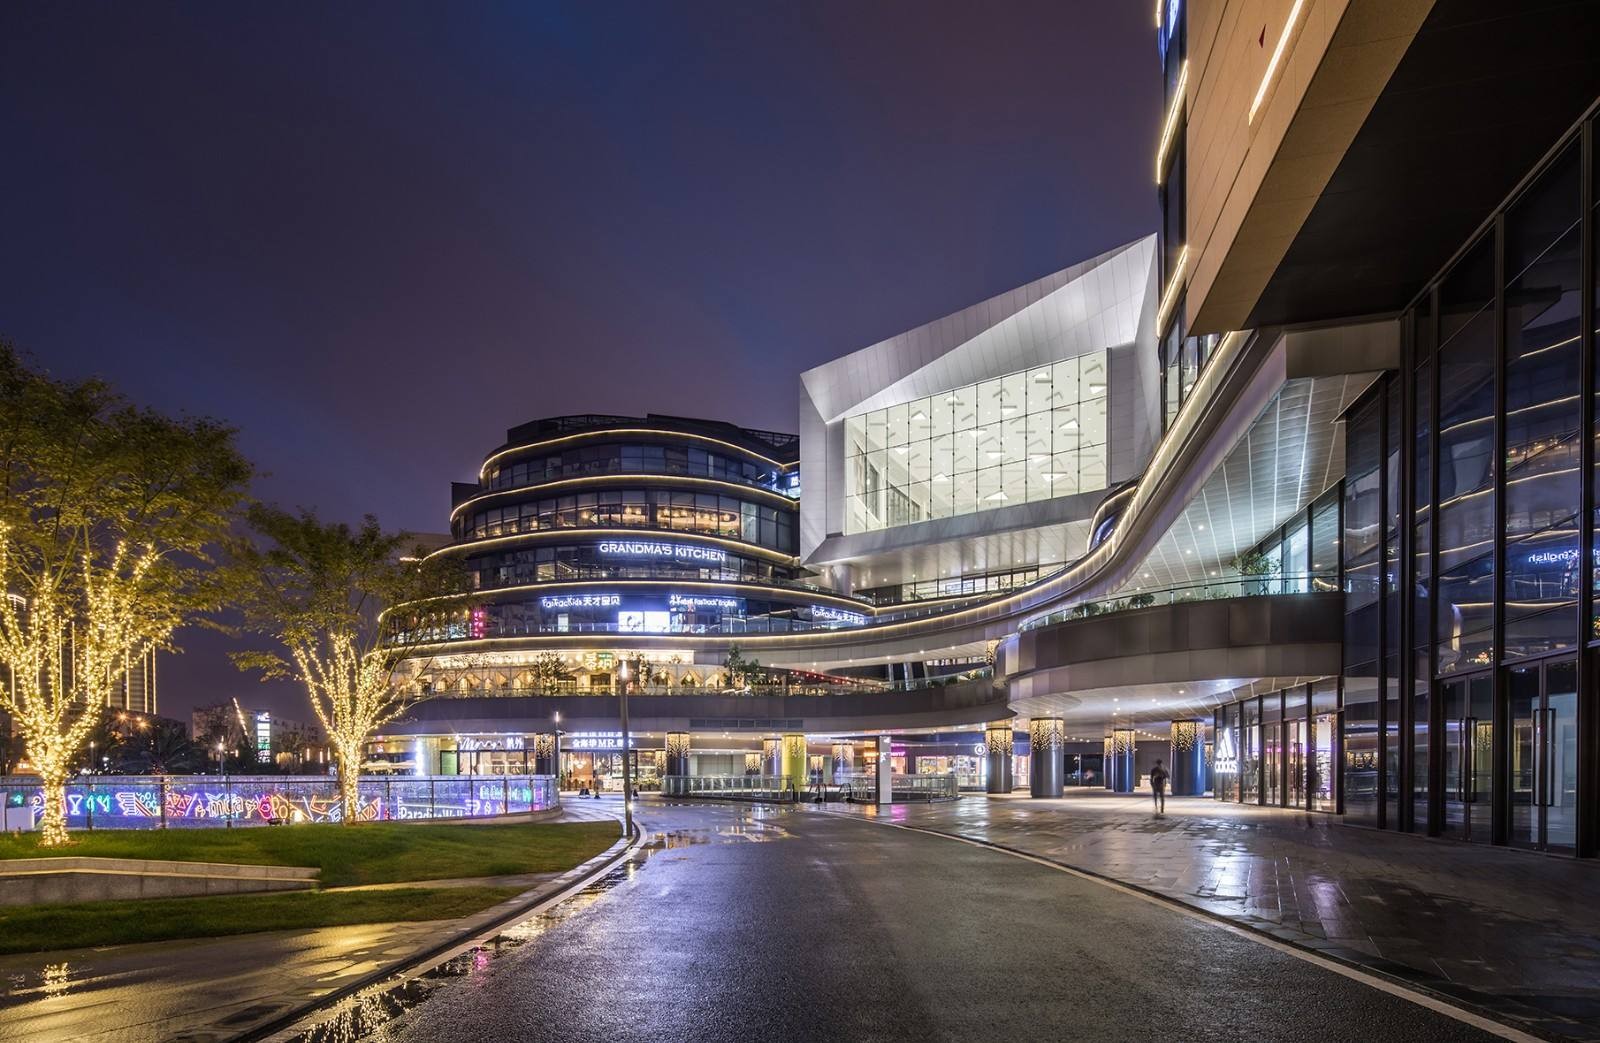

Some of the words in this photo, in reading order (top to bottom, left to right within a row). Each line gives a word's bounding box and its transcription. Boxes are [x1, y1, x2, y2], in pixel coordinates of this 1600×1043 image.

[599, 543, 672, 555] GRANDMA'S
[675, 547, 726, 561] KITCHEN
[1214, 758, 1238, 773] adidas
